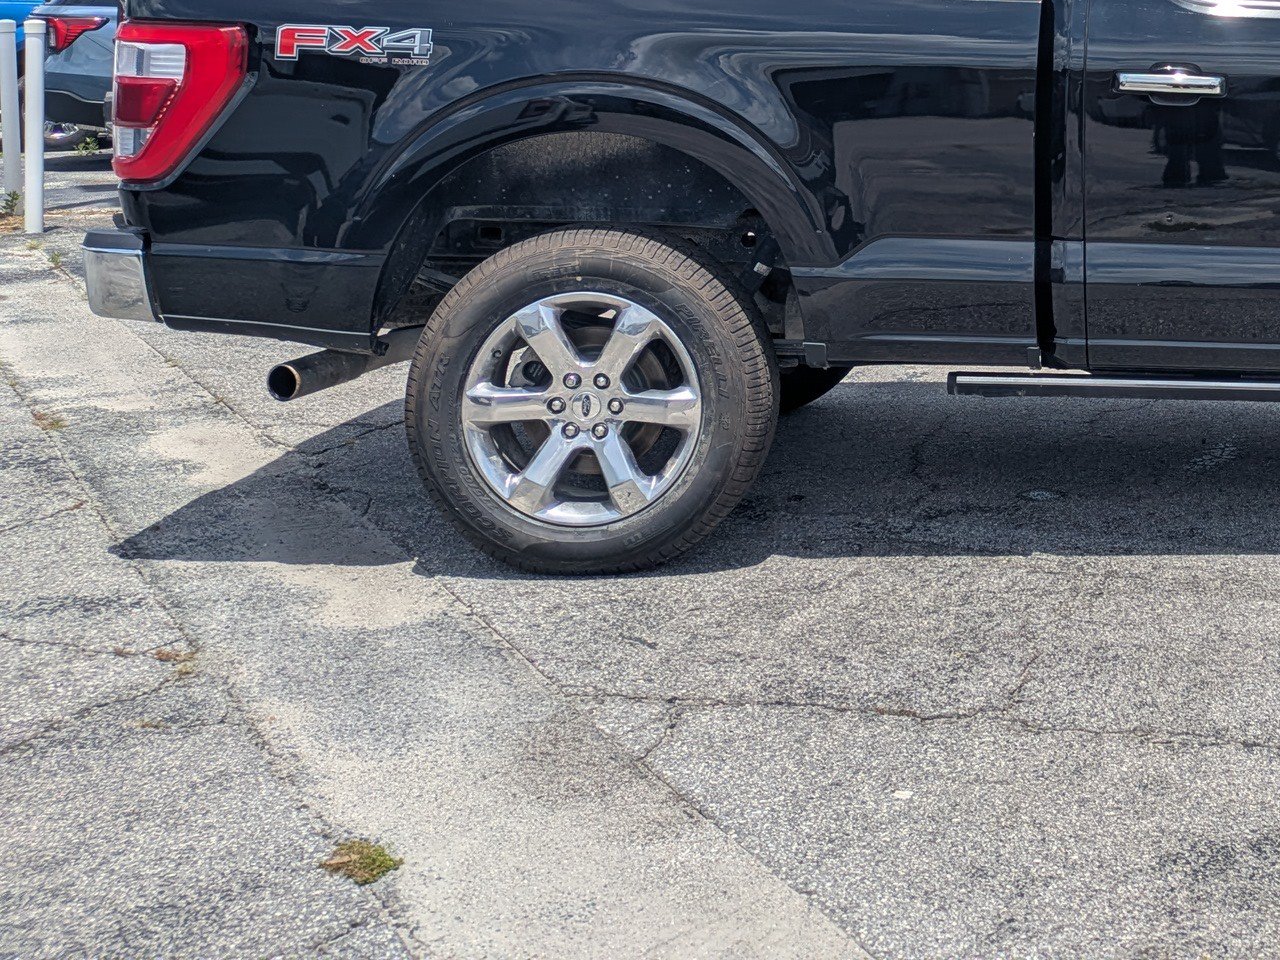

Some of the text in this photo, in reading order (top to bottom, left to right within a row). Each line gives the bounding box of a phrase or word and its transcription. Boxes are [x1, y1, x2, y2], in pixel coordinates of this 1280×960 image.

[274, 24, 433, 61] FX4
[392, 58, 430, 66] ROAD
[675, 303, 730, 399] PIRELLI
[427, 353, 515, 542] SCORPION ATR
